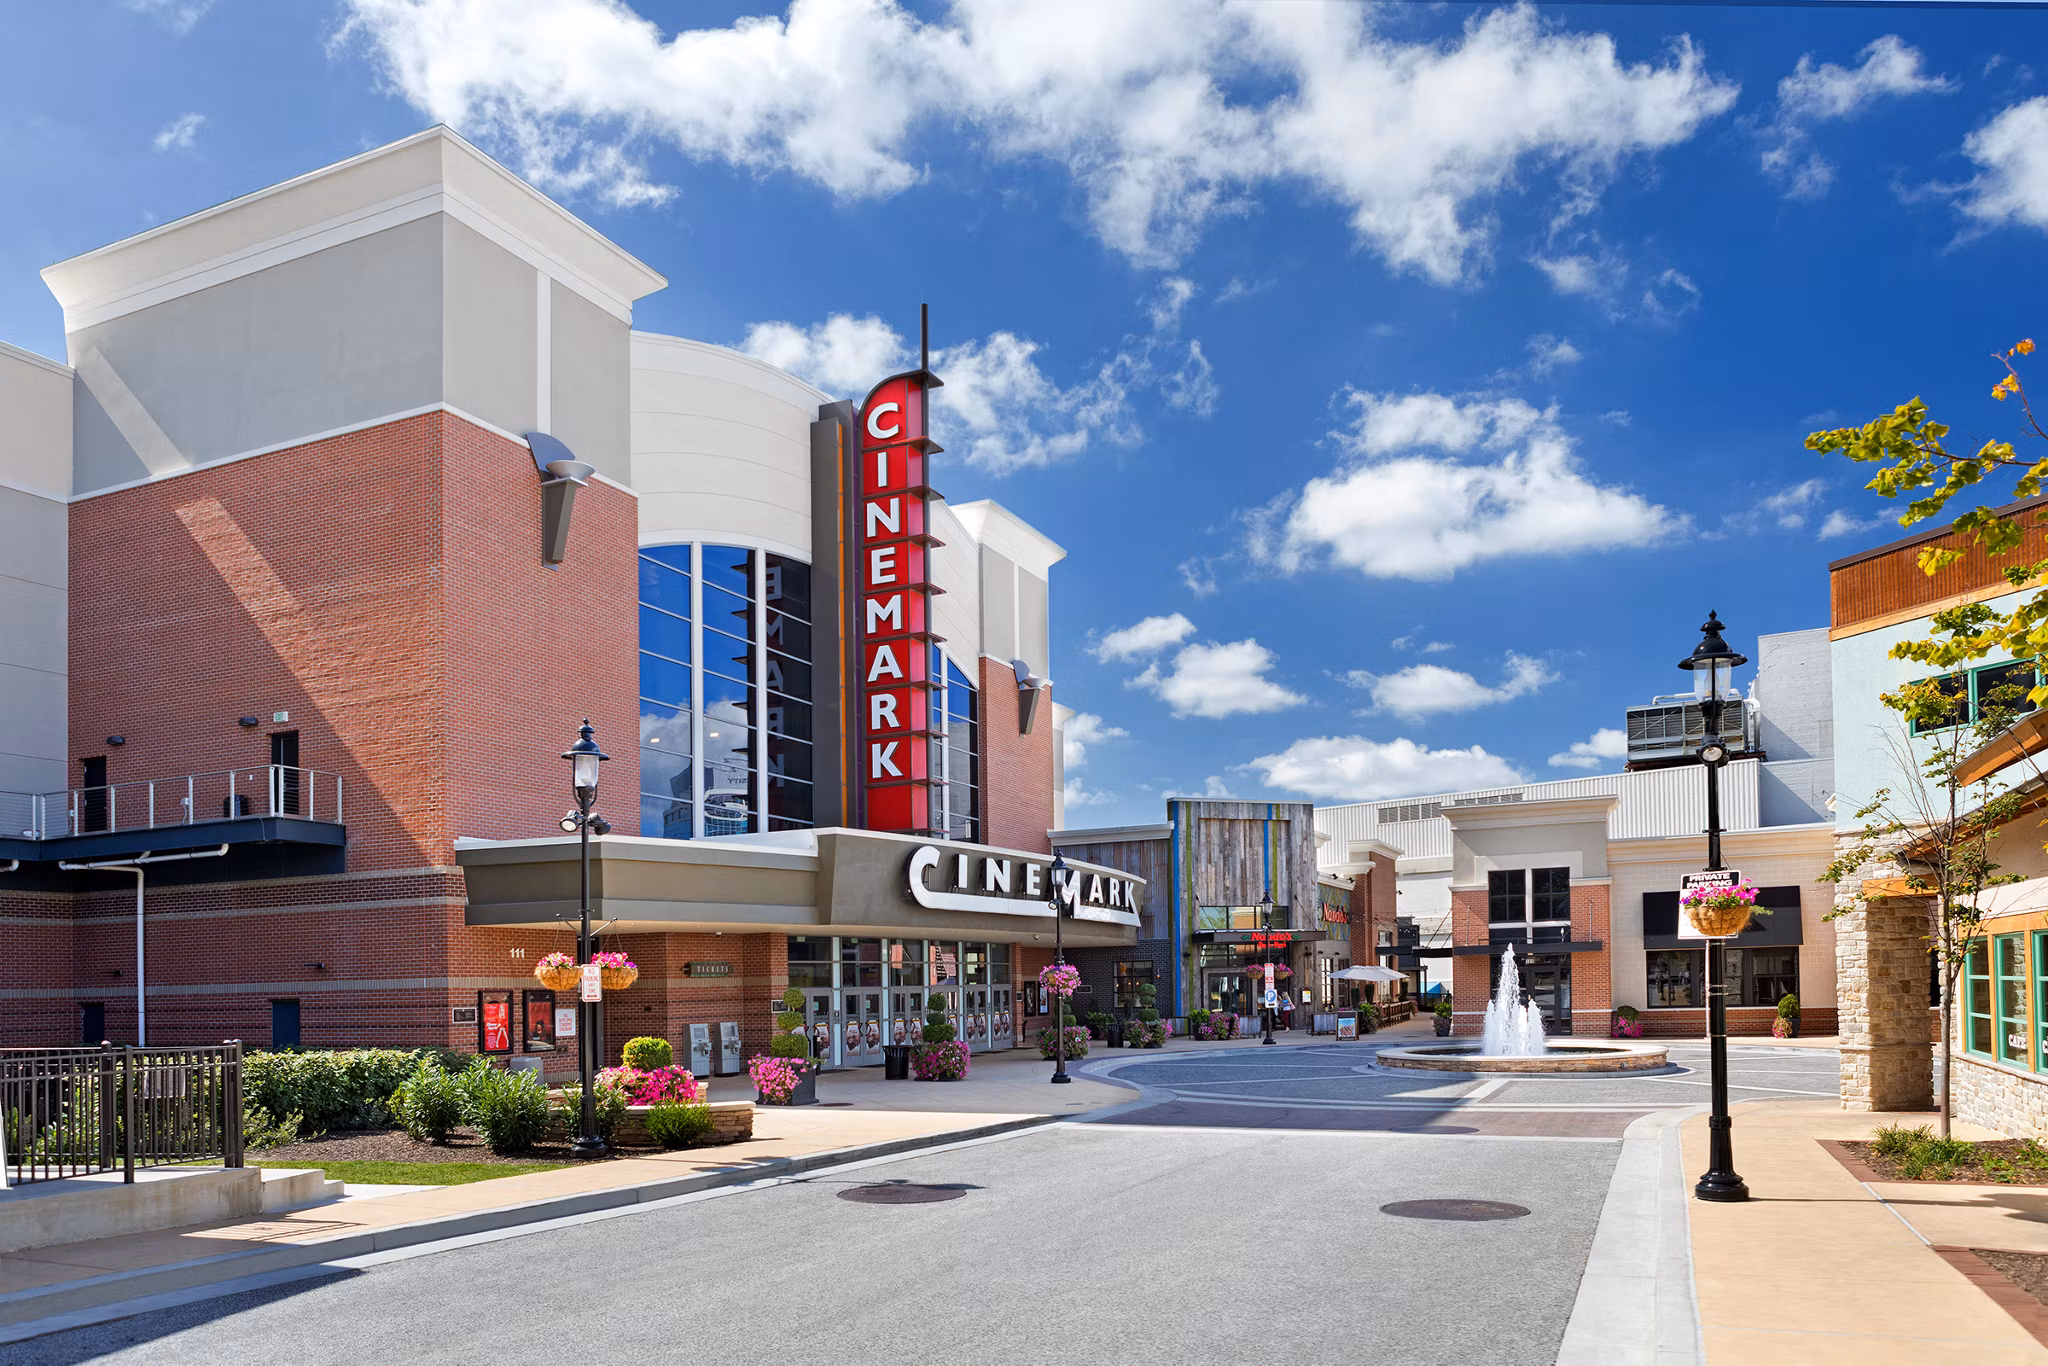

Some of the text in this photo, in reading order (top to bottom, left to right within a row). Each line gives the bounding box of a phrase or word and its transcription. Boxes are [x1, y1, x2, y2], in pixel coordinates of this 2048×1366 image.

[866, 402, 903, 779] CINEMARK
[1689, 873, 1731, 881] PRIVATE
[908, 845, 1142, 927] CINEMARK
[1686, 880, 1733, 889] PARKING
[509, 947, 525, 959] 111
[587, 967, 595, 975] NO
[697, 965, 729, 973] TICKETS
